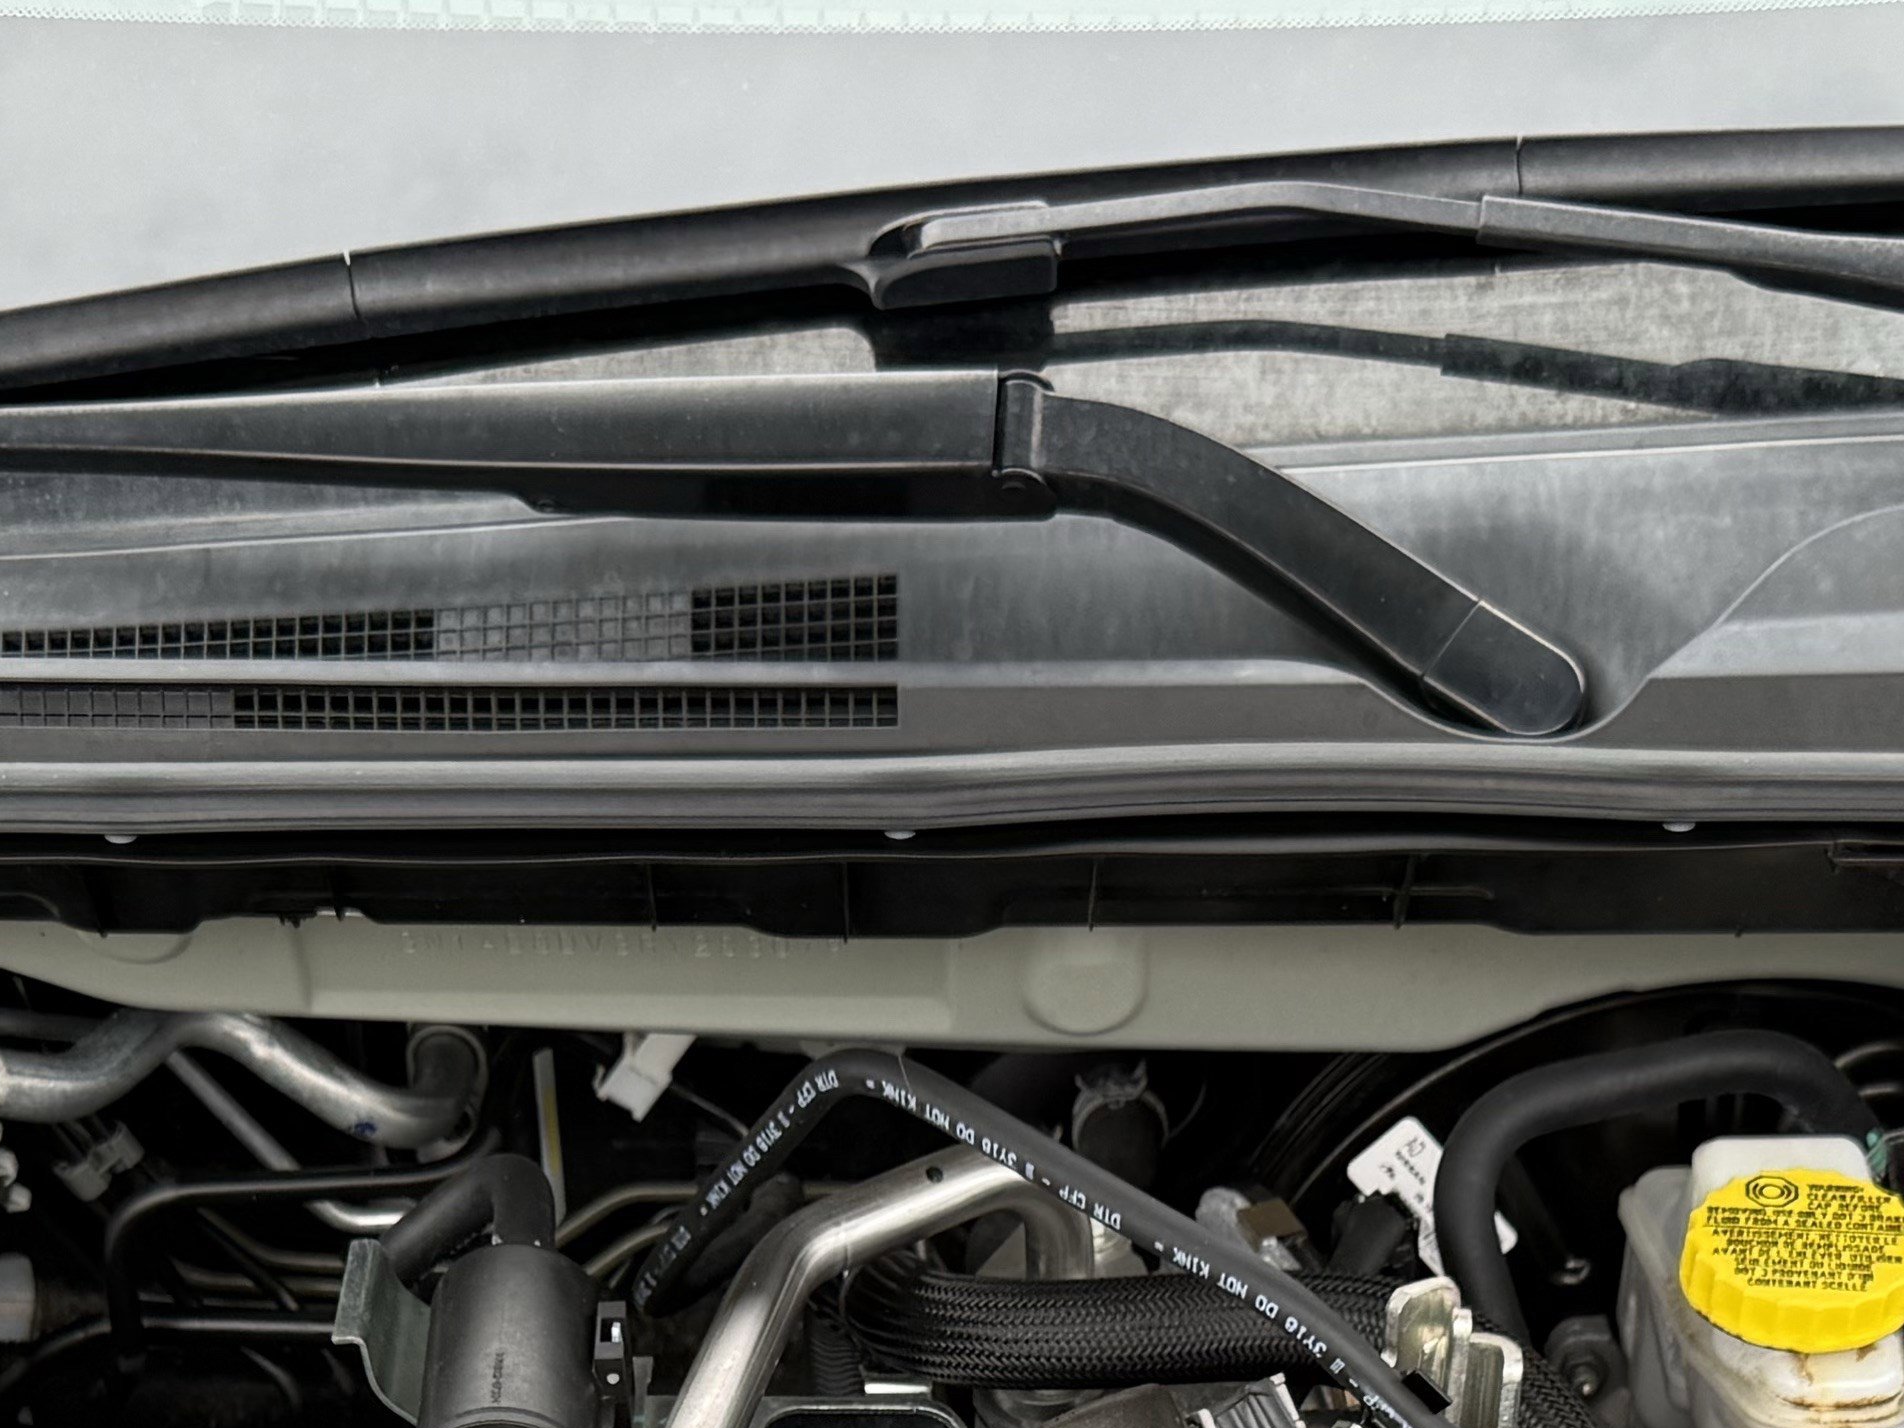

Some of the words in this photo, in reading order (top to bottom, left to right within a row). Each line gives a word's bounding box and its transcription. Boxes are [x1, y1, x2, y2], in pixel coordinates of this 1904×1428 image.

[880, 1080, 918, 1114] KINK
[925, 1103, 950, 1132] NOT
[955, 1122, 975, 1145] DO
[1173, 1247, 1210, 1279] KINK
[1217, 1272, 1248, 1299] NOT
[1255, 1295, 1279, 1318] DO
